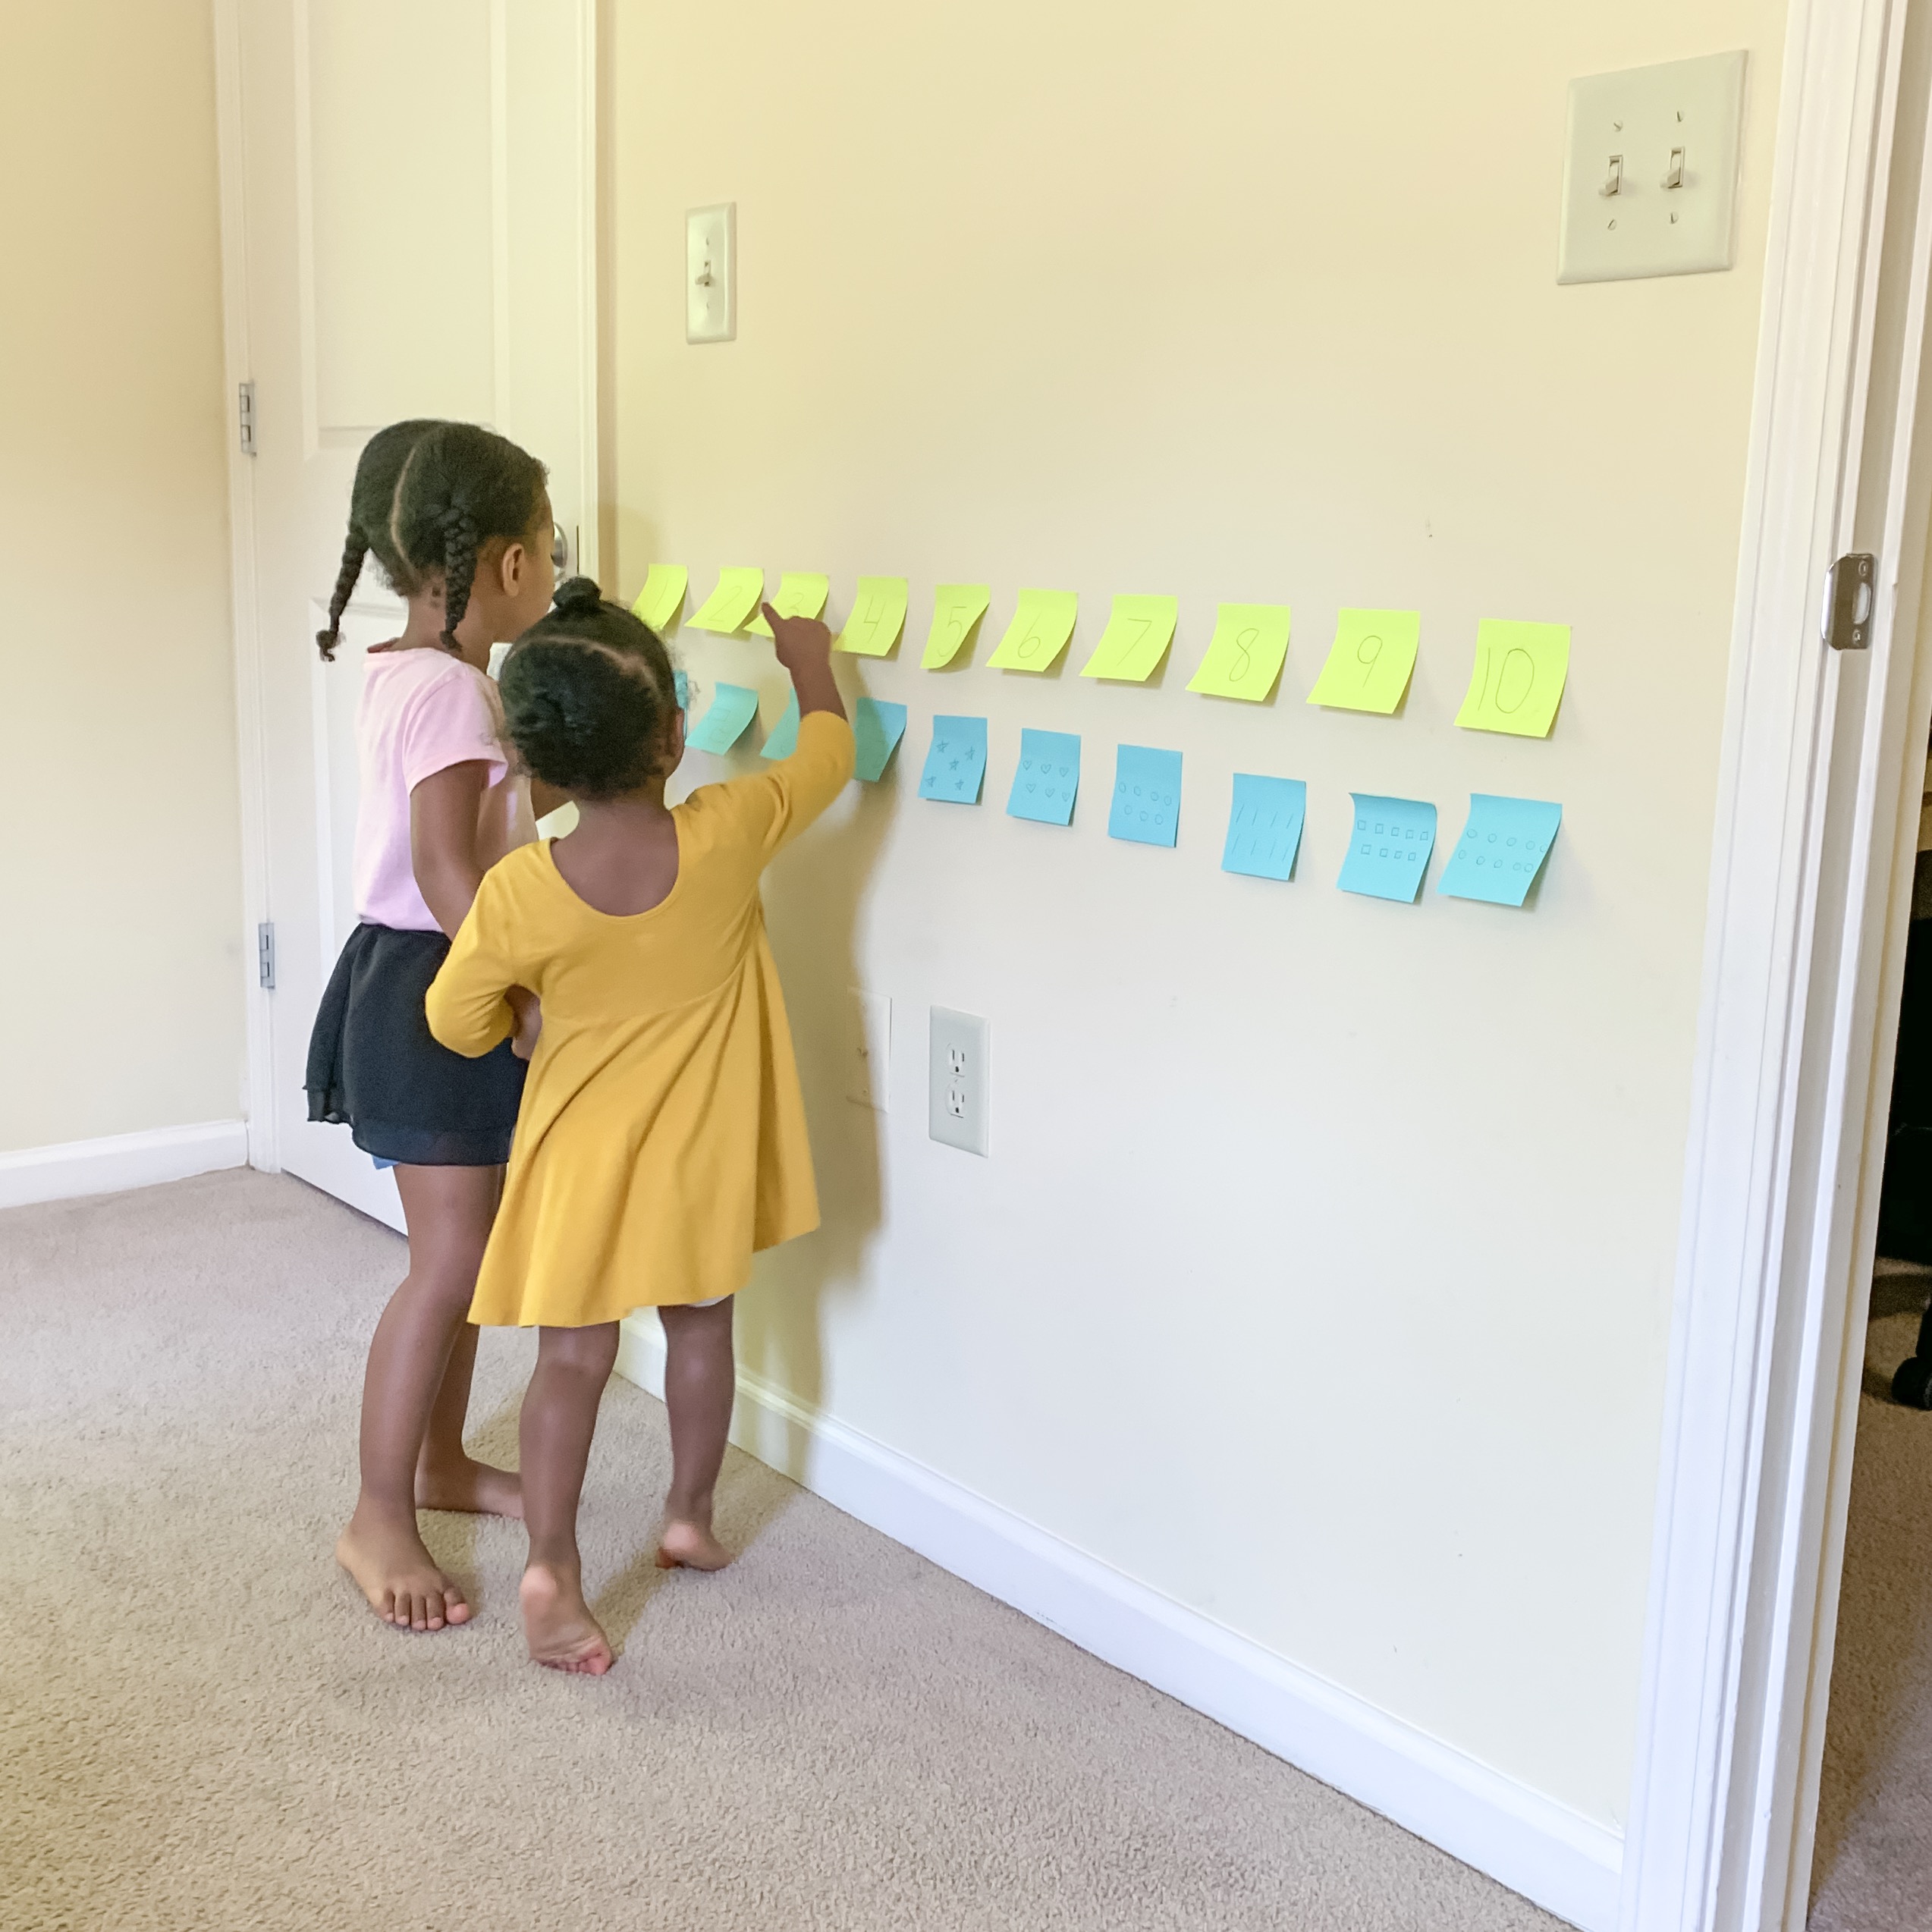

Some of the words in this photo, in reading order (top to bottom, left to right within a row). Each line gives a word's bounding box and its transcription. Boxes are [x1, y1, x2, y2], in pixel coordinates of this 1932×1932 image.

[707, 586, 743, 622] 2
[863, 595, 886, 643] 4
[937, 606, 967, 658] 5
[1017, 613, 1041, 658] 6
[1116, 618, 1152, 667] 7
[1229, 628, 1260, 682] 8
[1357, 635, 1383, 688] 9
[1478, 647, 1535, 714] 10
